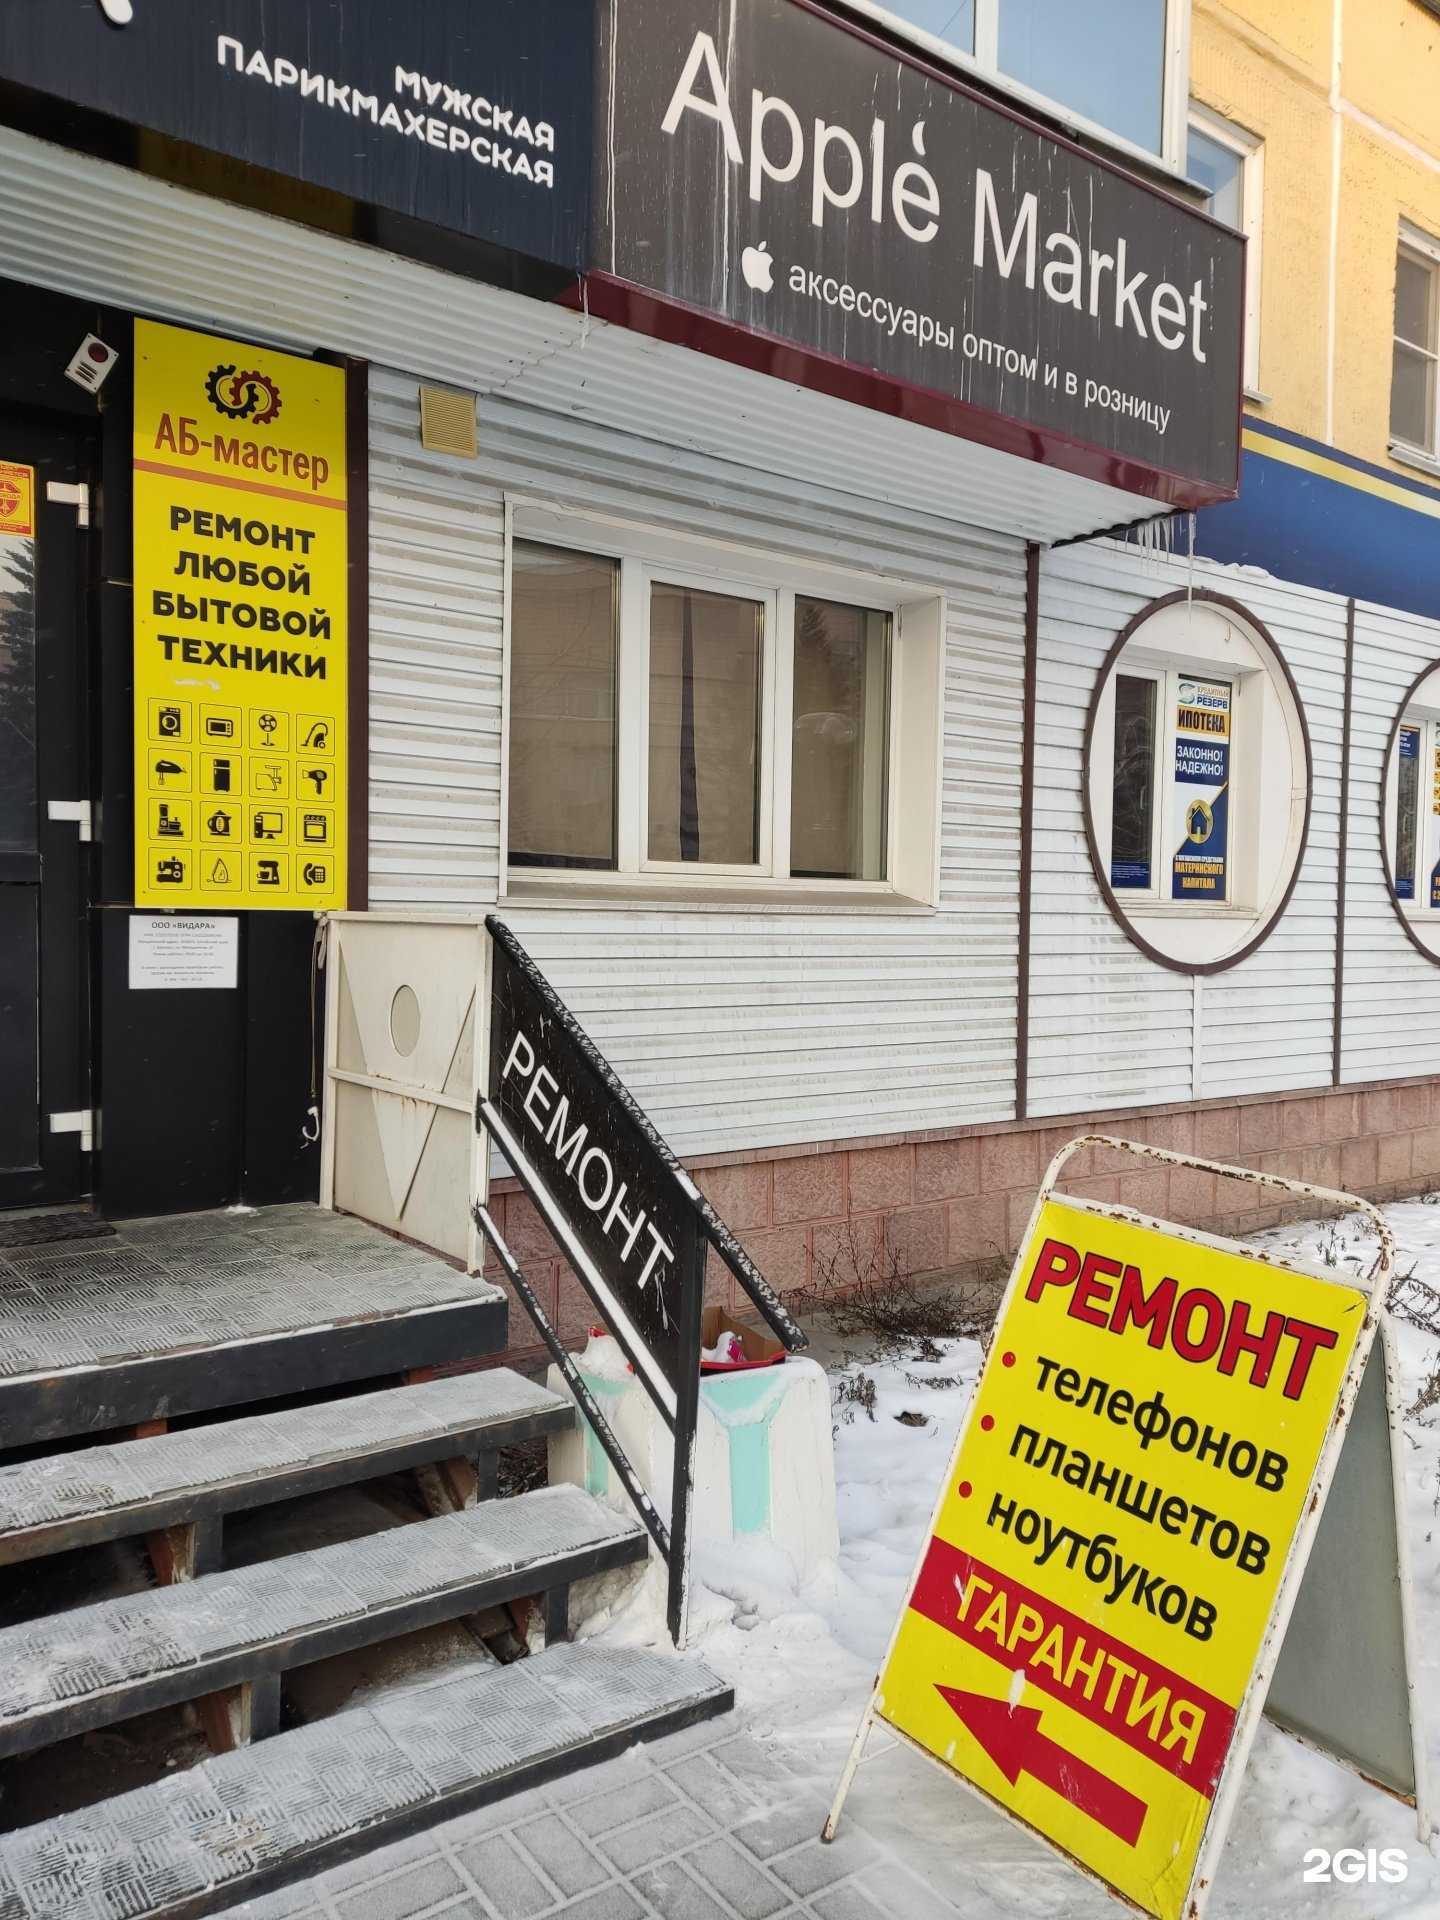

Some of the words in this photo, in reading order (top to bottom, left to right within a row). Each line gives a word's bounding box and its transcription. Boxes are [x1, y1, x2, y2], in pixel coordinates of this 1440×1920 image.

[216, 35, 556, 188] ПАРИКМАХЕРСКАЯ
[394, 65, 556, 152] МУЖСКАЯ
[660, 31, 942, 244] Apple
[973, 168, 1208, 364] Market
[789, 262, 955, 352] аксессуары
[962, 332, 1037, 381] оптом
[1044, 363, 1058, 388] и
[1066, 372, 1079, 396] в
[1085, 378, 1171, 435] розницу
[154, 413, 328, 490] АБ-мастер
[170, 505, 315, 553] РЕМОНТ
[152, 589, 331, 640] БЫТОВОЙ
[174, 550, 311, 596] ЛЮБОЙ
[157, 634, 327, 680] ТЕХНИКИ
[1196, 696, 1228, 709] РЕЗЕРВ
[1175, 760, 1224, 776] НАДЕЖНО!
[1177, 745, 1223, 762] ЗАКОННО!
[151, 921, 170, 929] ООО
[502, 1030, 675, 1290] РЕМОНТ
[1024, 1237, 1338, 1401] РЕМОНТ
[1036, 1353, 1290, 1494] телефонов
[1008, 1422, 1270, 1577] планшетов
[986, 1492, 1218, 1642] ноутбуков
[955, 1572, 1207, 1766] ГАРАНТИЯ
